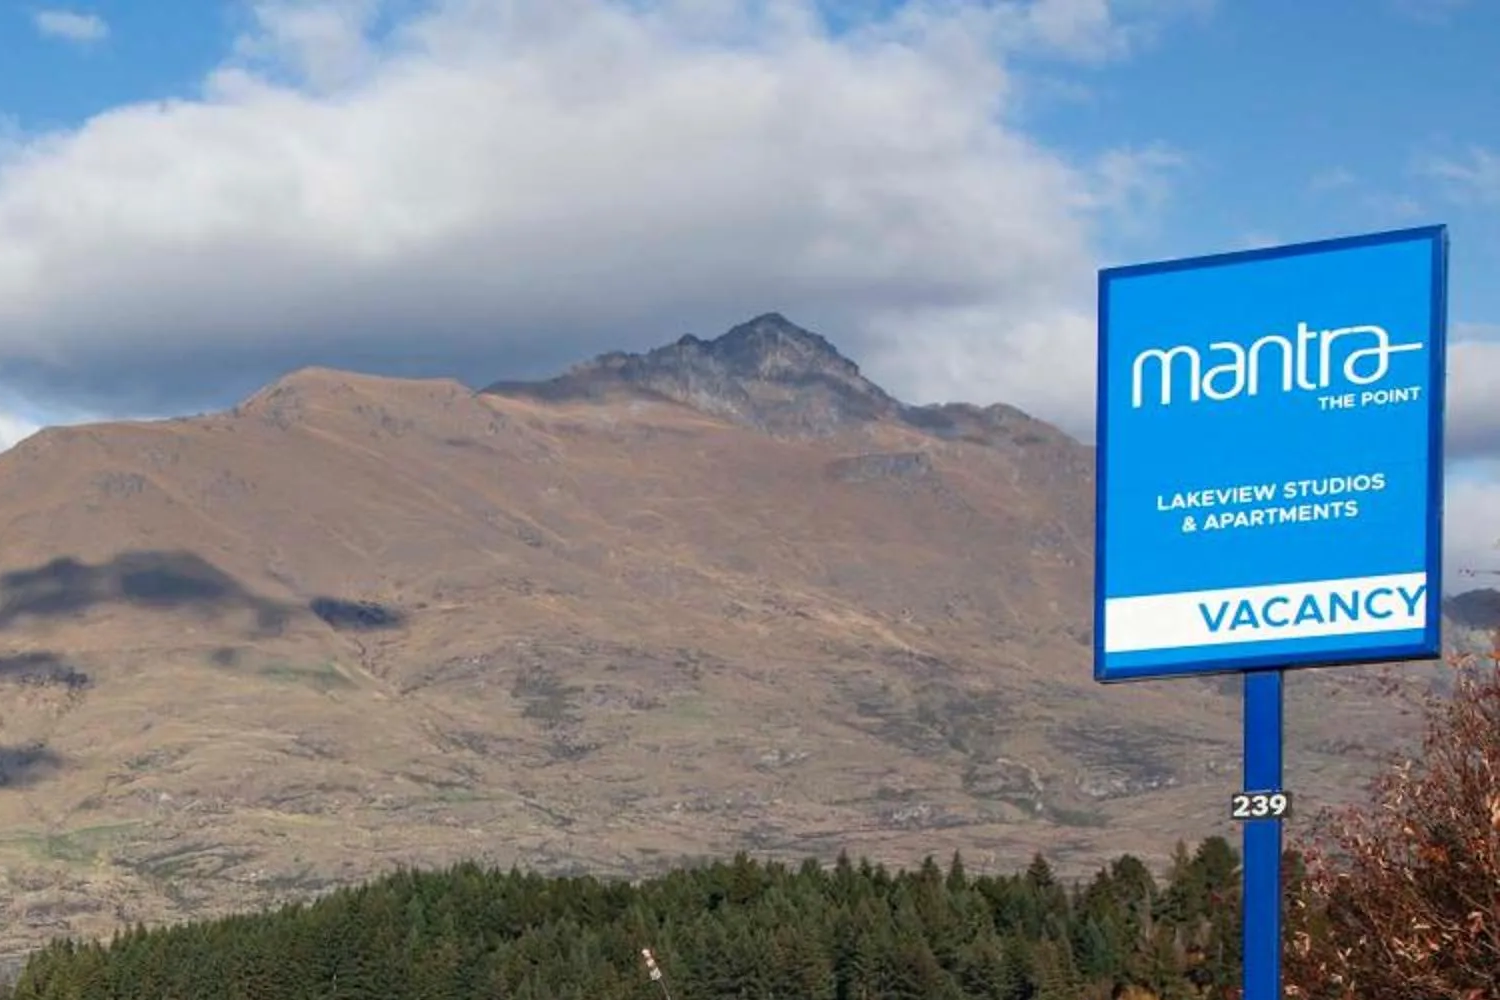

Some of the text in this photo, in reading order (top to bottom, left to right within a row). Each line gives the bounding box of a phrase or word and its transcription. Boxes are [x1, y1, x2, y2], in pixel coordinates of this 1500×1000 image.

[1132, 322, 1423, 408] mantra
[1318, 386, 1422, 411] THE POINT
[1157, 473, 1386, 511] LAKEVIEW STUDIOS
[1181, 501, 1359, 533] & APARTMENTS
[1198, 585, 1426, 633] VACANCY
[1233, 794, 1288, 817] 239
